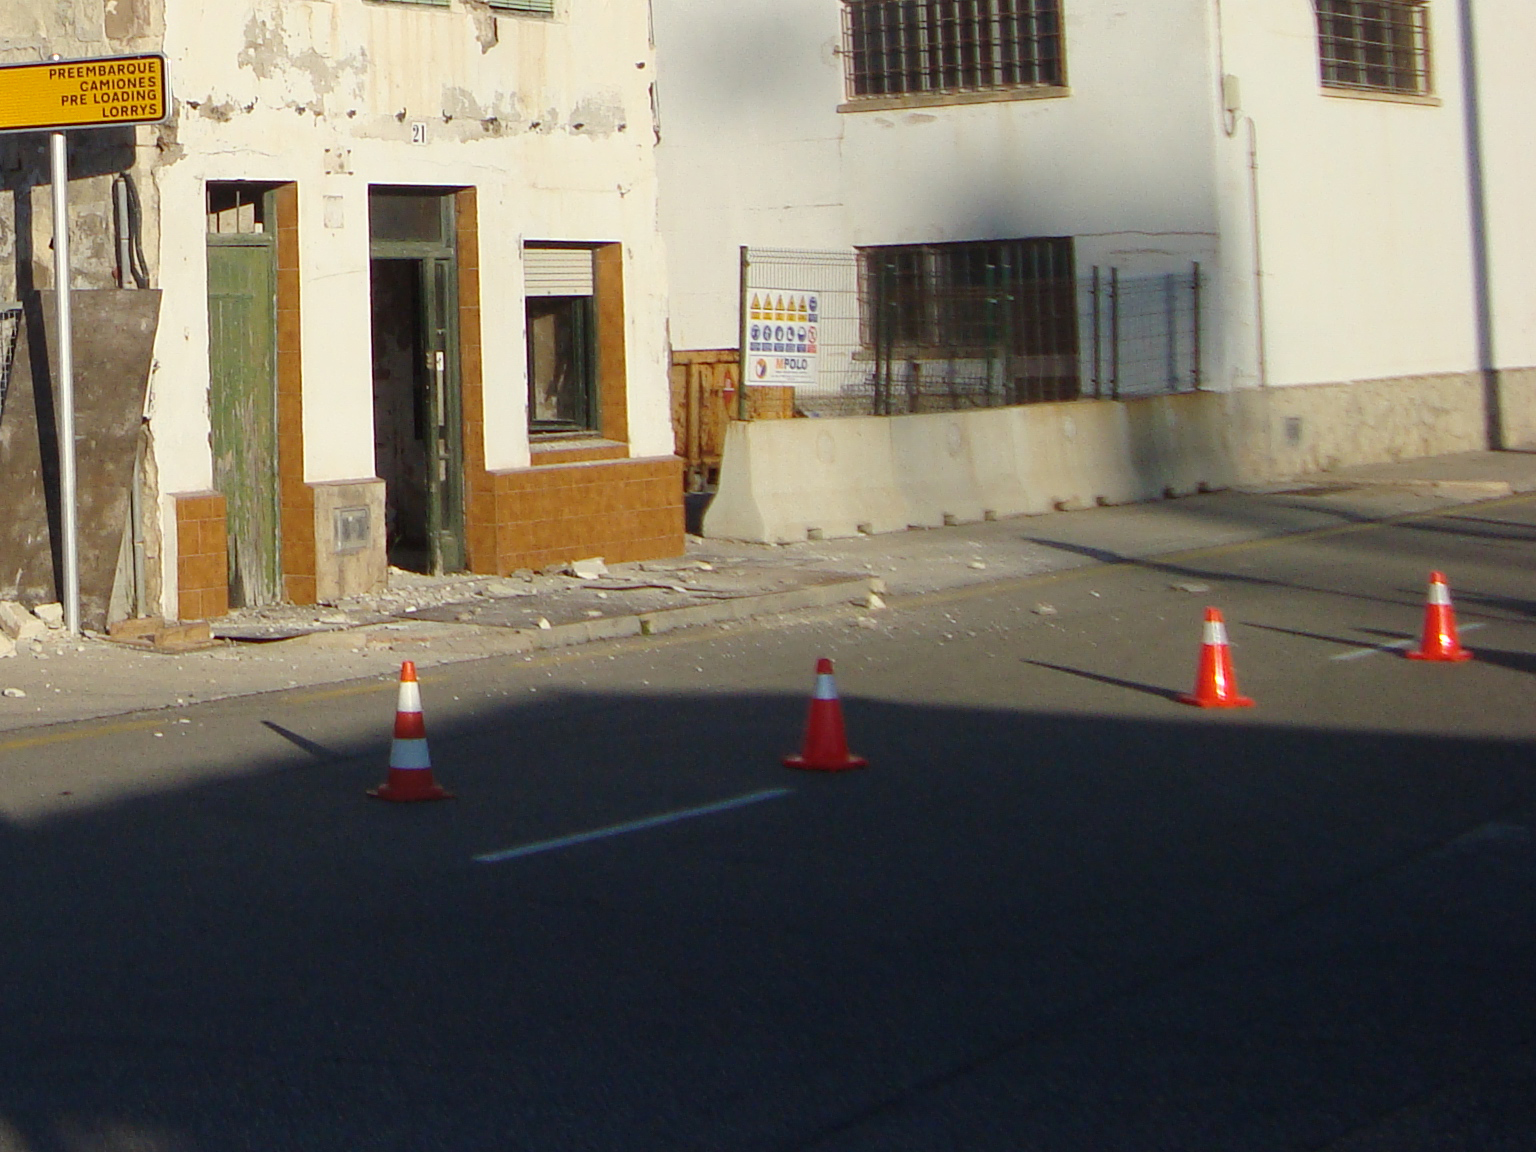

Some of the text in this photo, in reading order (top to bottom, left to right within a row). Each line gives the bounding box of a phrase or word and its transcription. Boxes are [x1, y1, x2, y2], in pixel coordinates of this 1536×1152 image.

[49, 61, 156, 80] PREEMBARQUE
[80, 76, 157, 92] CAMIONES
[61, 89, 157, 106] PRE LOADING
[102, 104, 157, 118] LORRYS
[412, 124, 425, 144] 21
